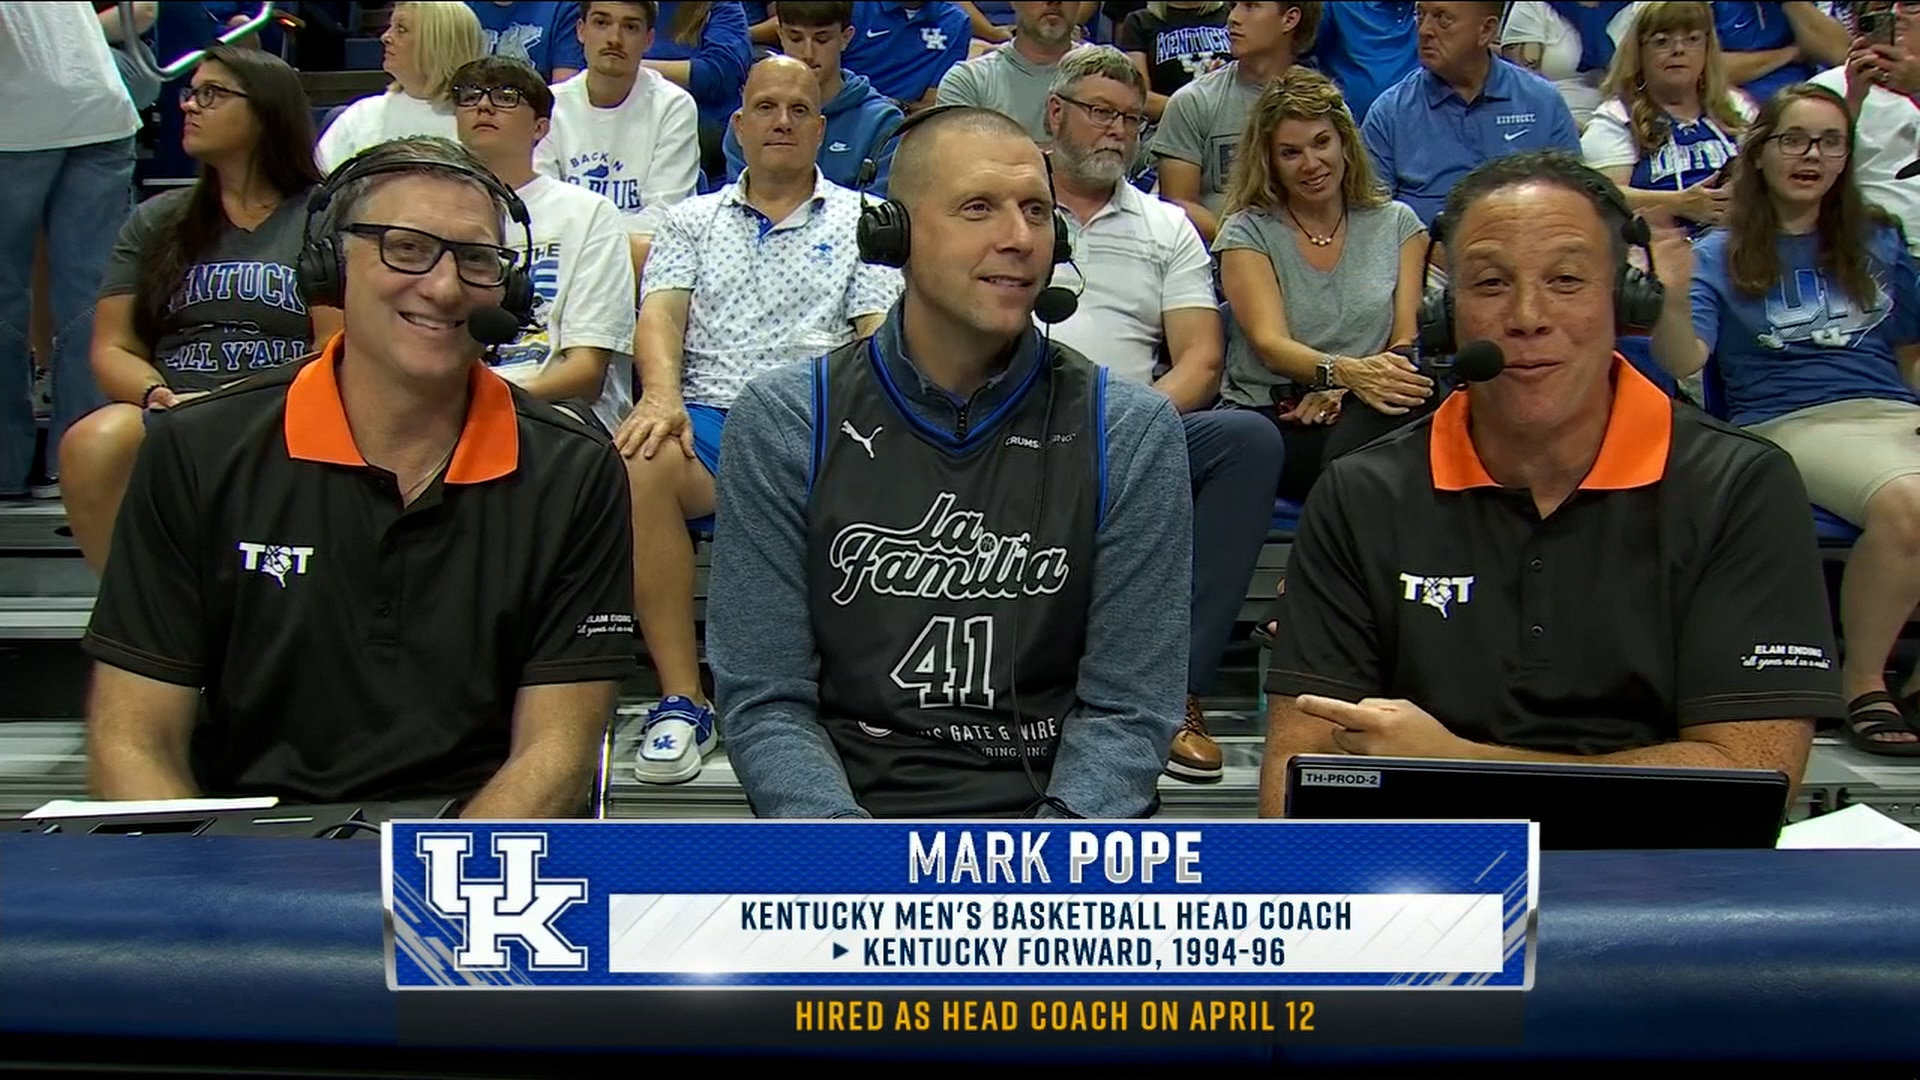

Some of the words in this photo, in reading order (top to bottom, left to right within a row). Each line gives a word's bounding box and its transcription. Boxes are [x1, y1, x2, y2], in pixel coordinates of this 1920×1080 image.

[570, 152, 609, 168] BACK
[830, 523, 1069, 606] Familia
[889, 615, 994, 709] 41
[951, 725, 994, 742] GATE
[1306, 773, 1378, 785] TH-PROD-2
